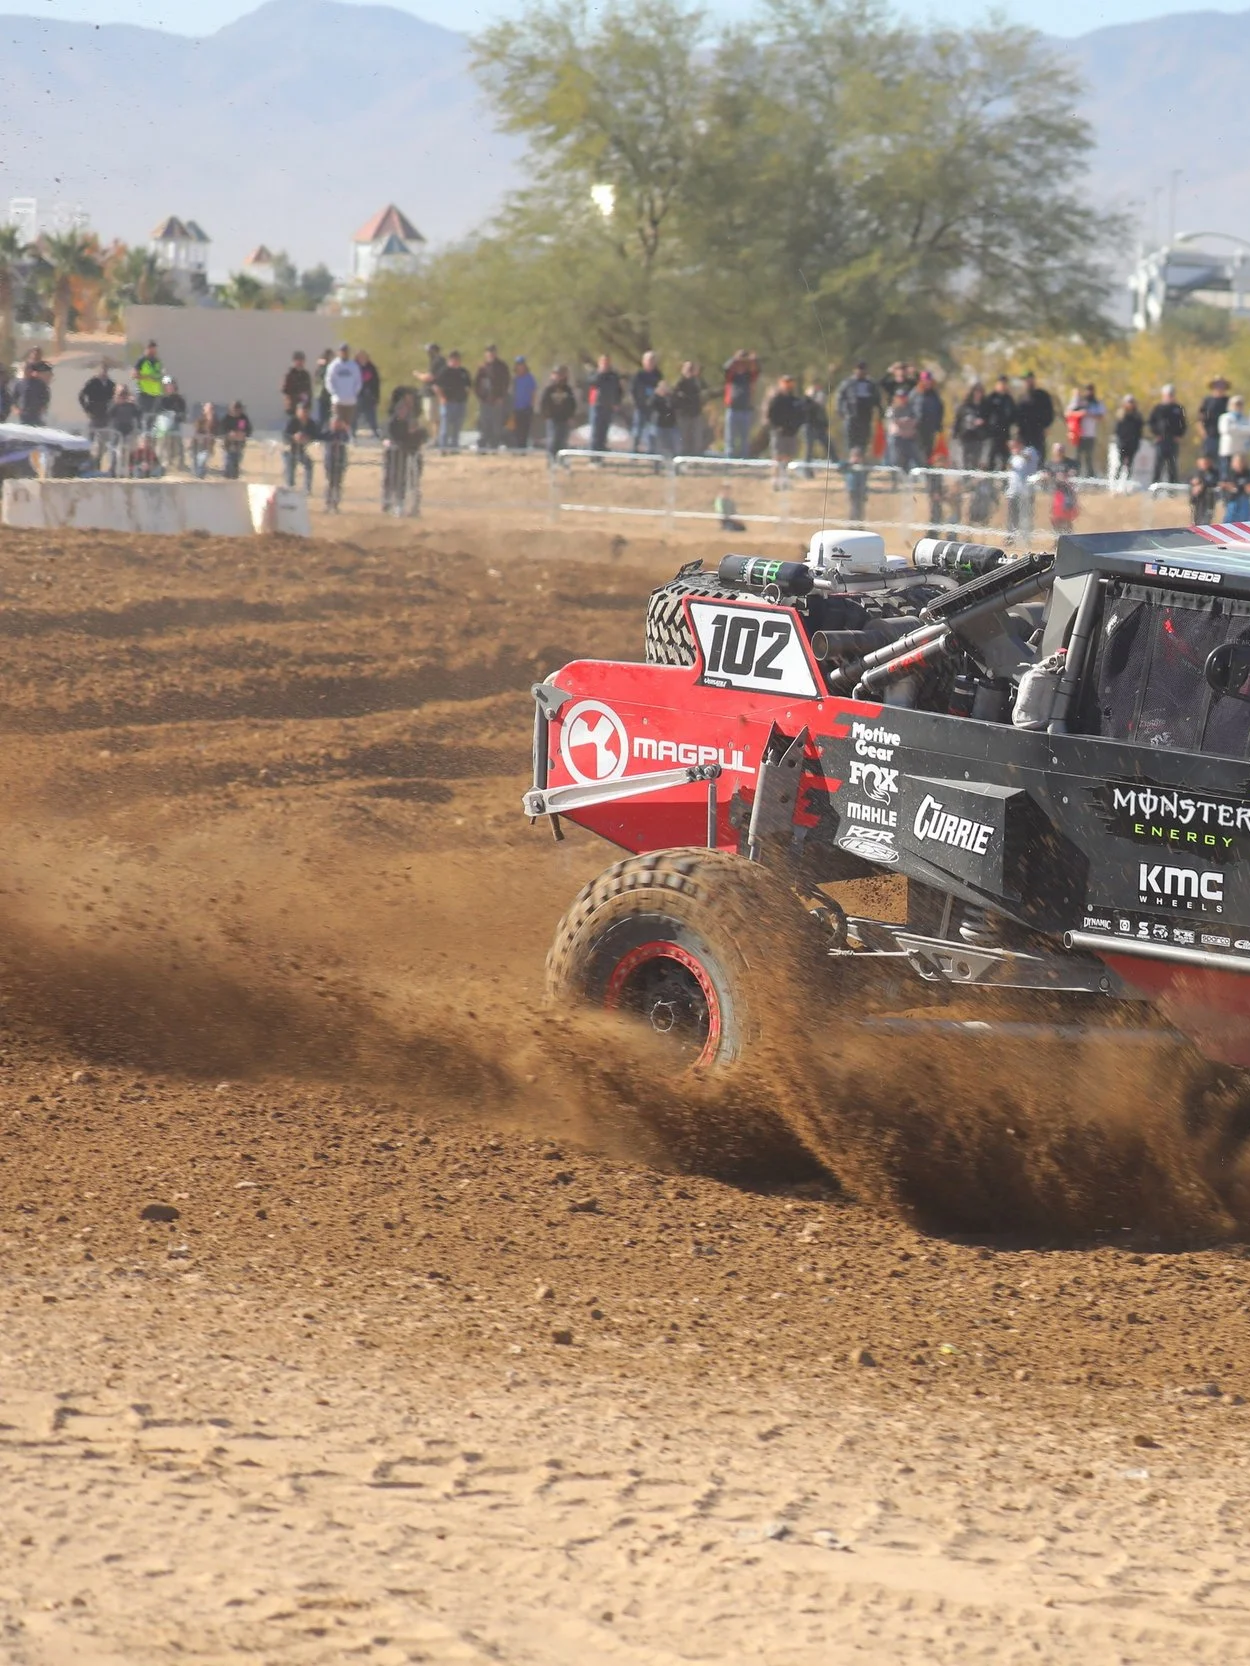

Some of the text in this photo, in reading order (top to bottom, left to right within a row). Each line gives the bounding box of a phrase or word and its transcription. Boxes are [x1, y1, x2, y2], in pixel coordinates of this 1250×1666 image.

[707, 614, 792, 680] 102
[852, 722, 900, 746] Motive
[633, 736, 755, 774] MAGPUL
[855, 739, 894, 762] Gear
[849, 761, 899, 800] FOX
[847, 801, 897, 827] MAHLE
[913, 793, 995, 855] CURRIE
[846, 825, 895, 844] RZR
[1134, 823, 1233, 848] ENERGY
[1139, 895, 1223, 914] WHEELS
